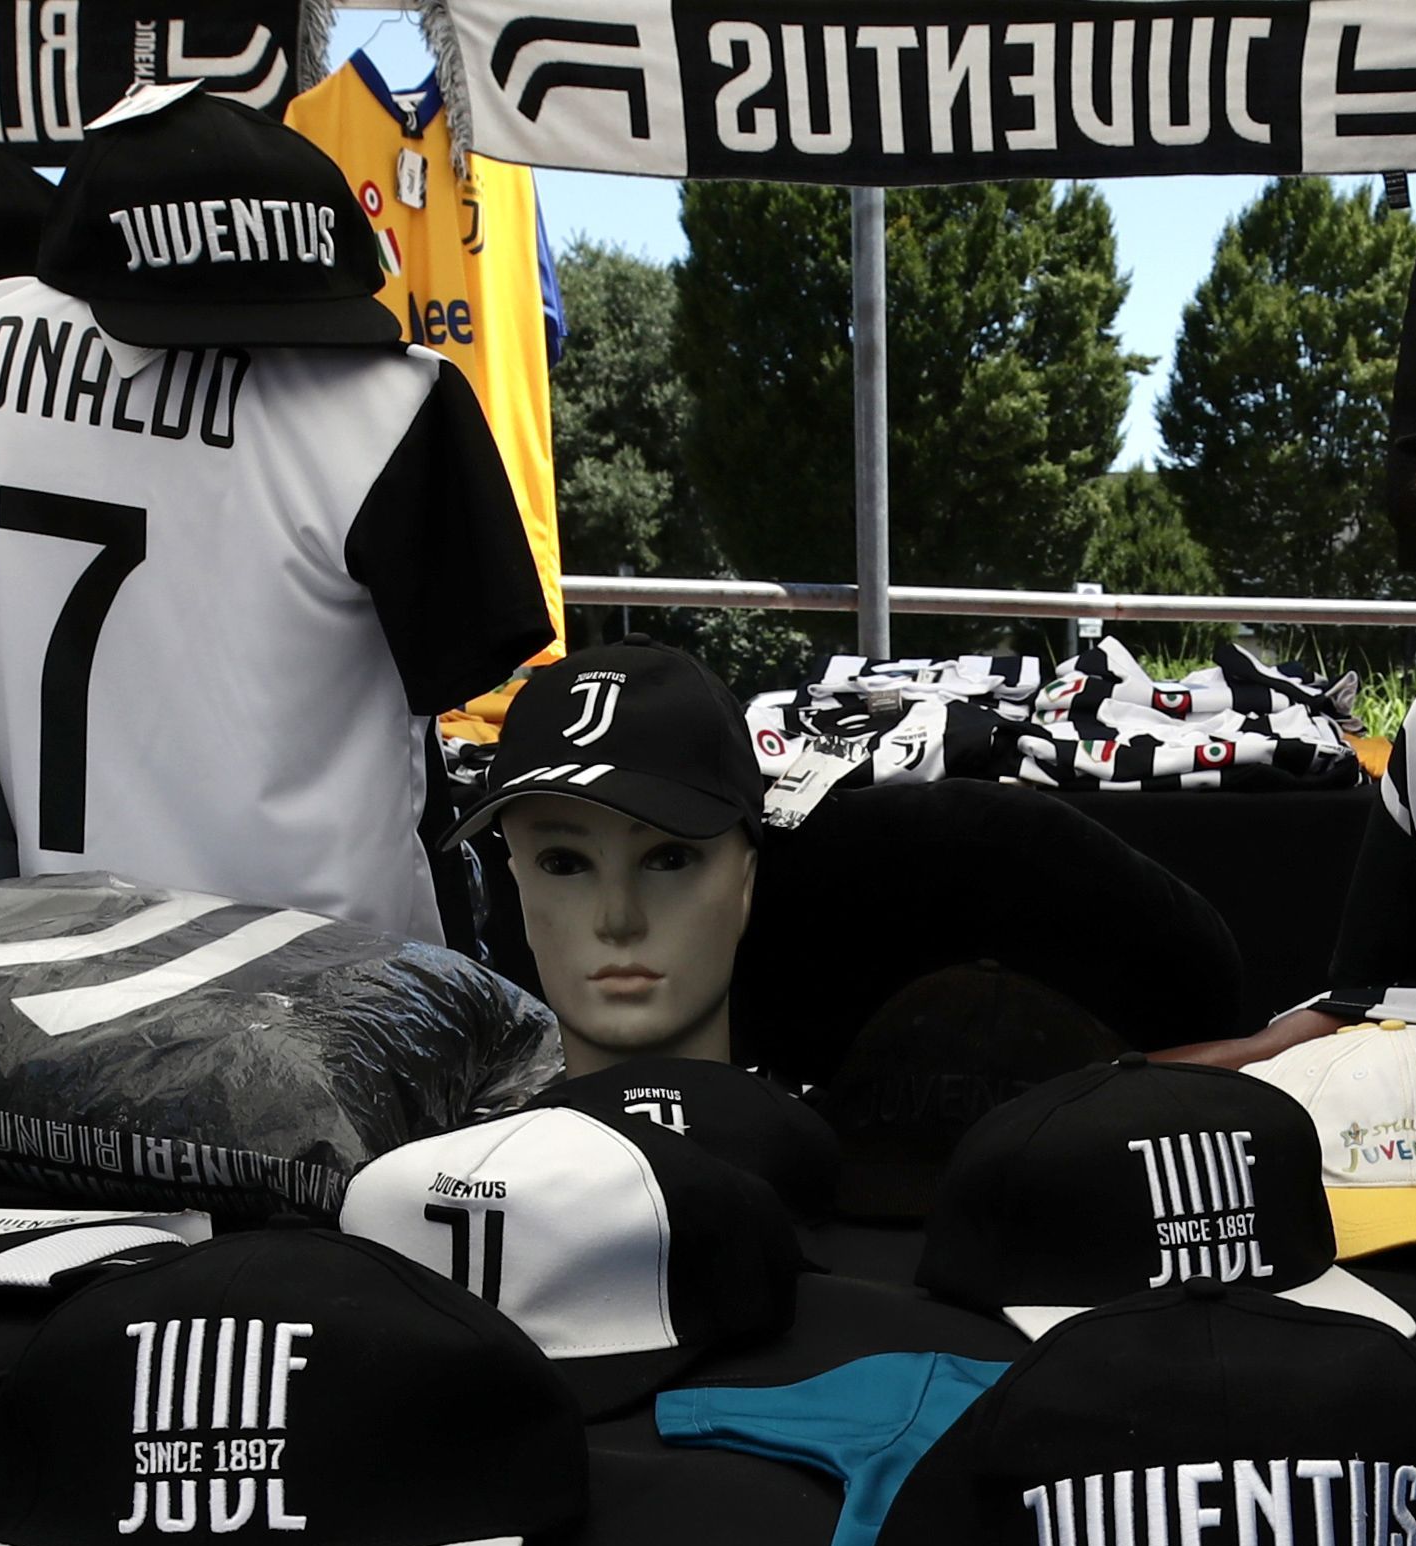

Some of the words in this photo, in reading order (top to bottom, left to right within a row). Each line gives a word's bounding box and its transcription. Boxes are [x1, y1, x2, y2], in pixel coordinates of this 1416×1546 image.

[109, 198, 336, 271] JUVENTUS
[575, 671, 627, 684] JUVENTUS
[623, 1087, 682, 1101] JUVENTUS
[429, 1171, 508, 1200] JUVENTUS
[1157, 1218, 1210, 1247] SINCE
[1216, 1212, 1256, 1241] 1897
[134, 1439, 203, 1474] SINCE
[213, 1438, 287, 1473] 1897
